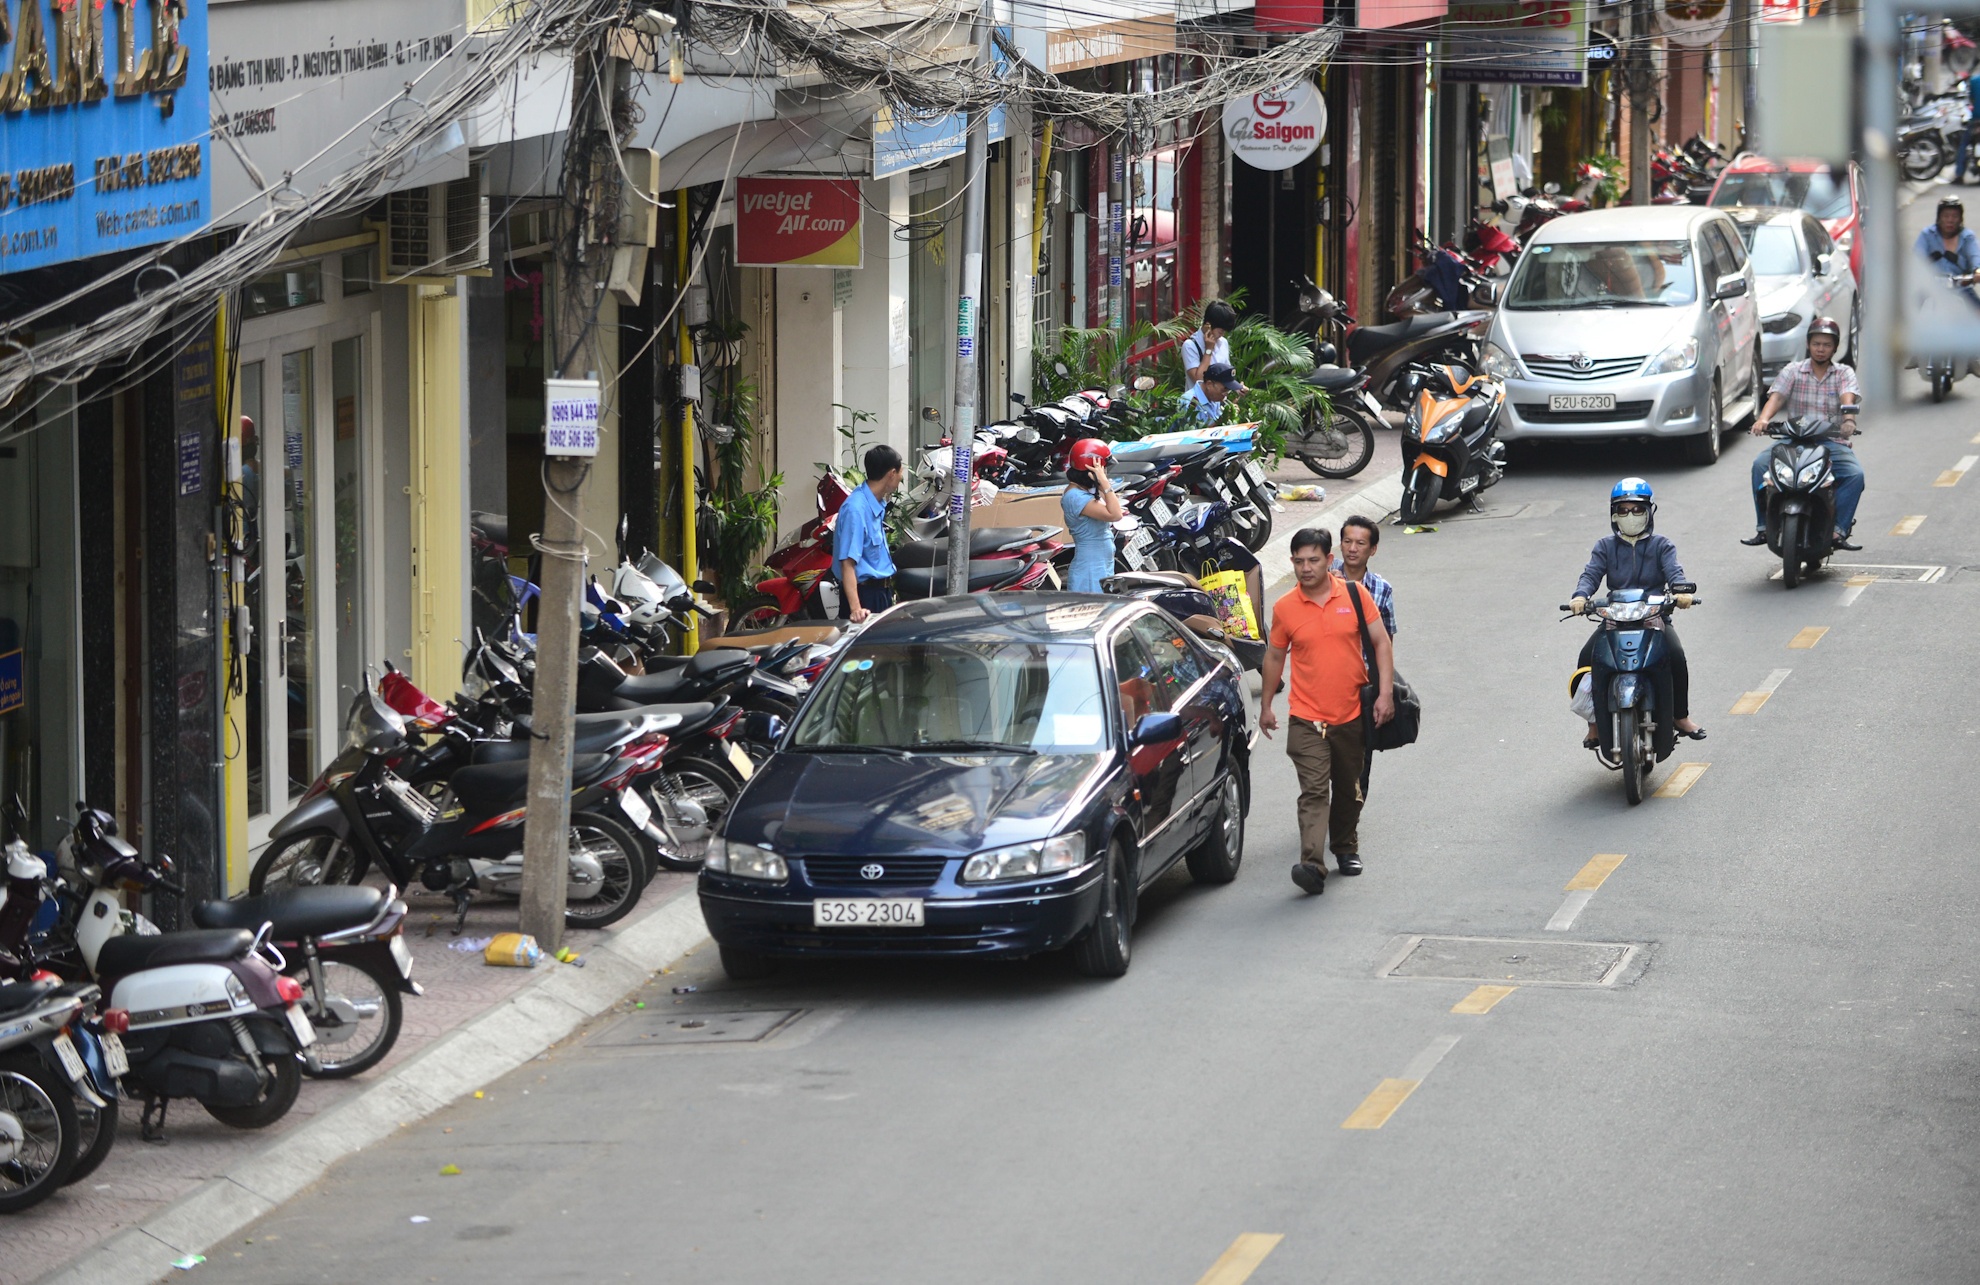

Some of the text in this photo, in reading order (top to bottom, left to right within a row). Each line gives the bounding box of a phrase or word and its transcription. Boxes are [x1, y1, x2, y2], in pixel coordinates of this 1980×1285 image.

[1521, 1, 1572, 28] 25
[217, 56, 245, 96] ĐẶNG
[247, 59, 263, 92] THỊ
[344, 40, 365, 73] THÁI
[1253, 121, 1315, 144] Saigon
[1289, 144, 1307, 153] Coffee
[552, 403, 598, 421] 0909 844 393
[550, 429, 567, 447] 0982
[366, 810, 392, 818] HONDA
